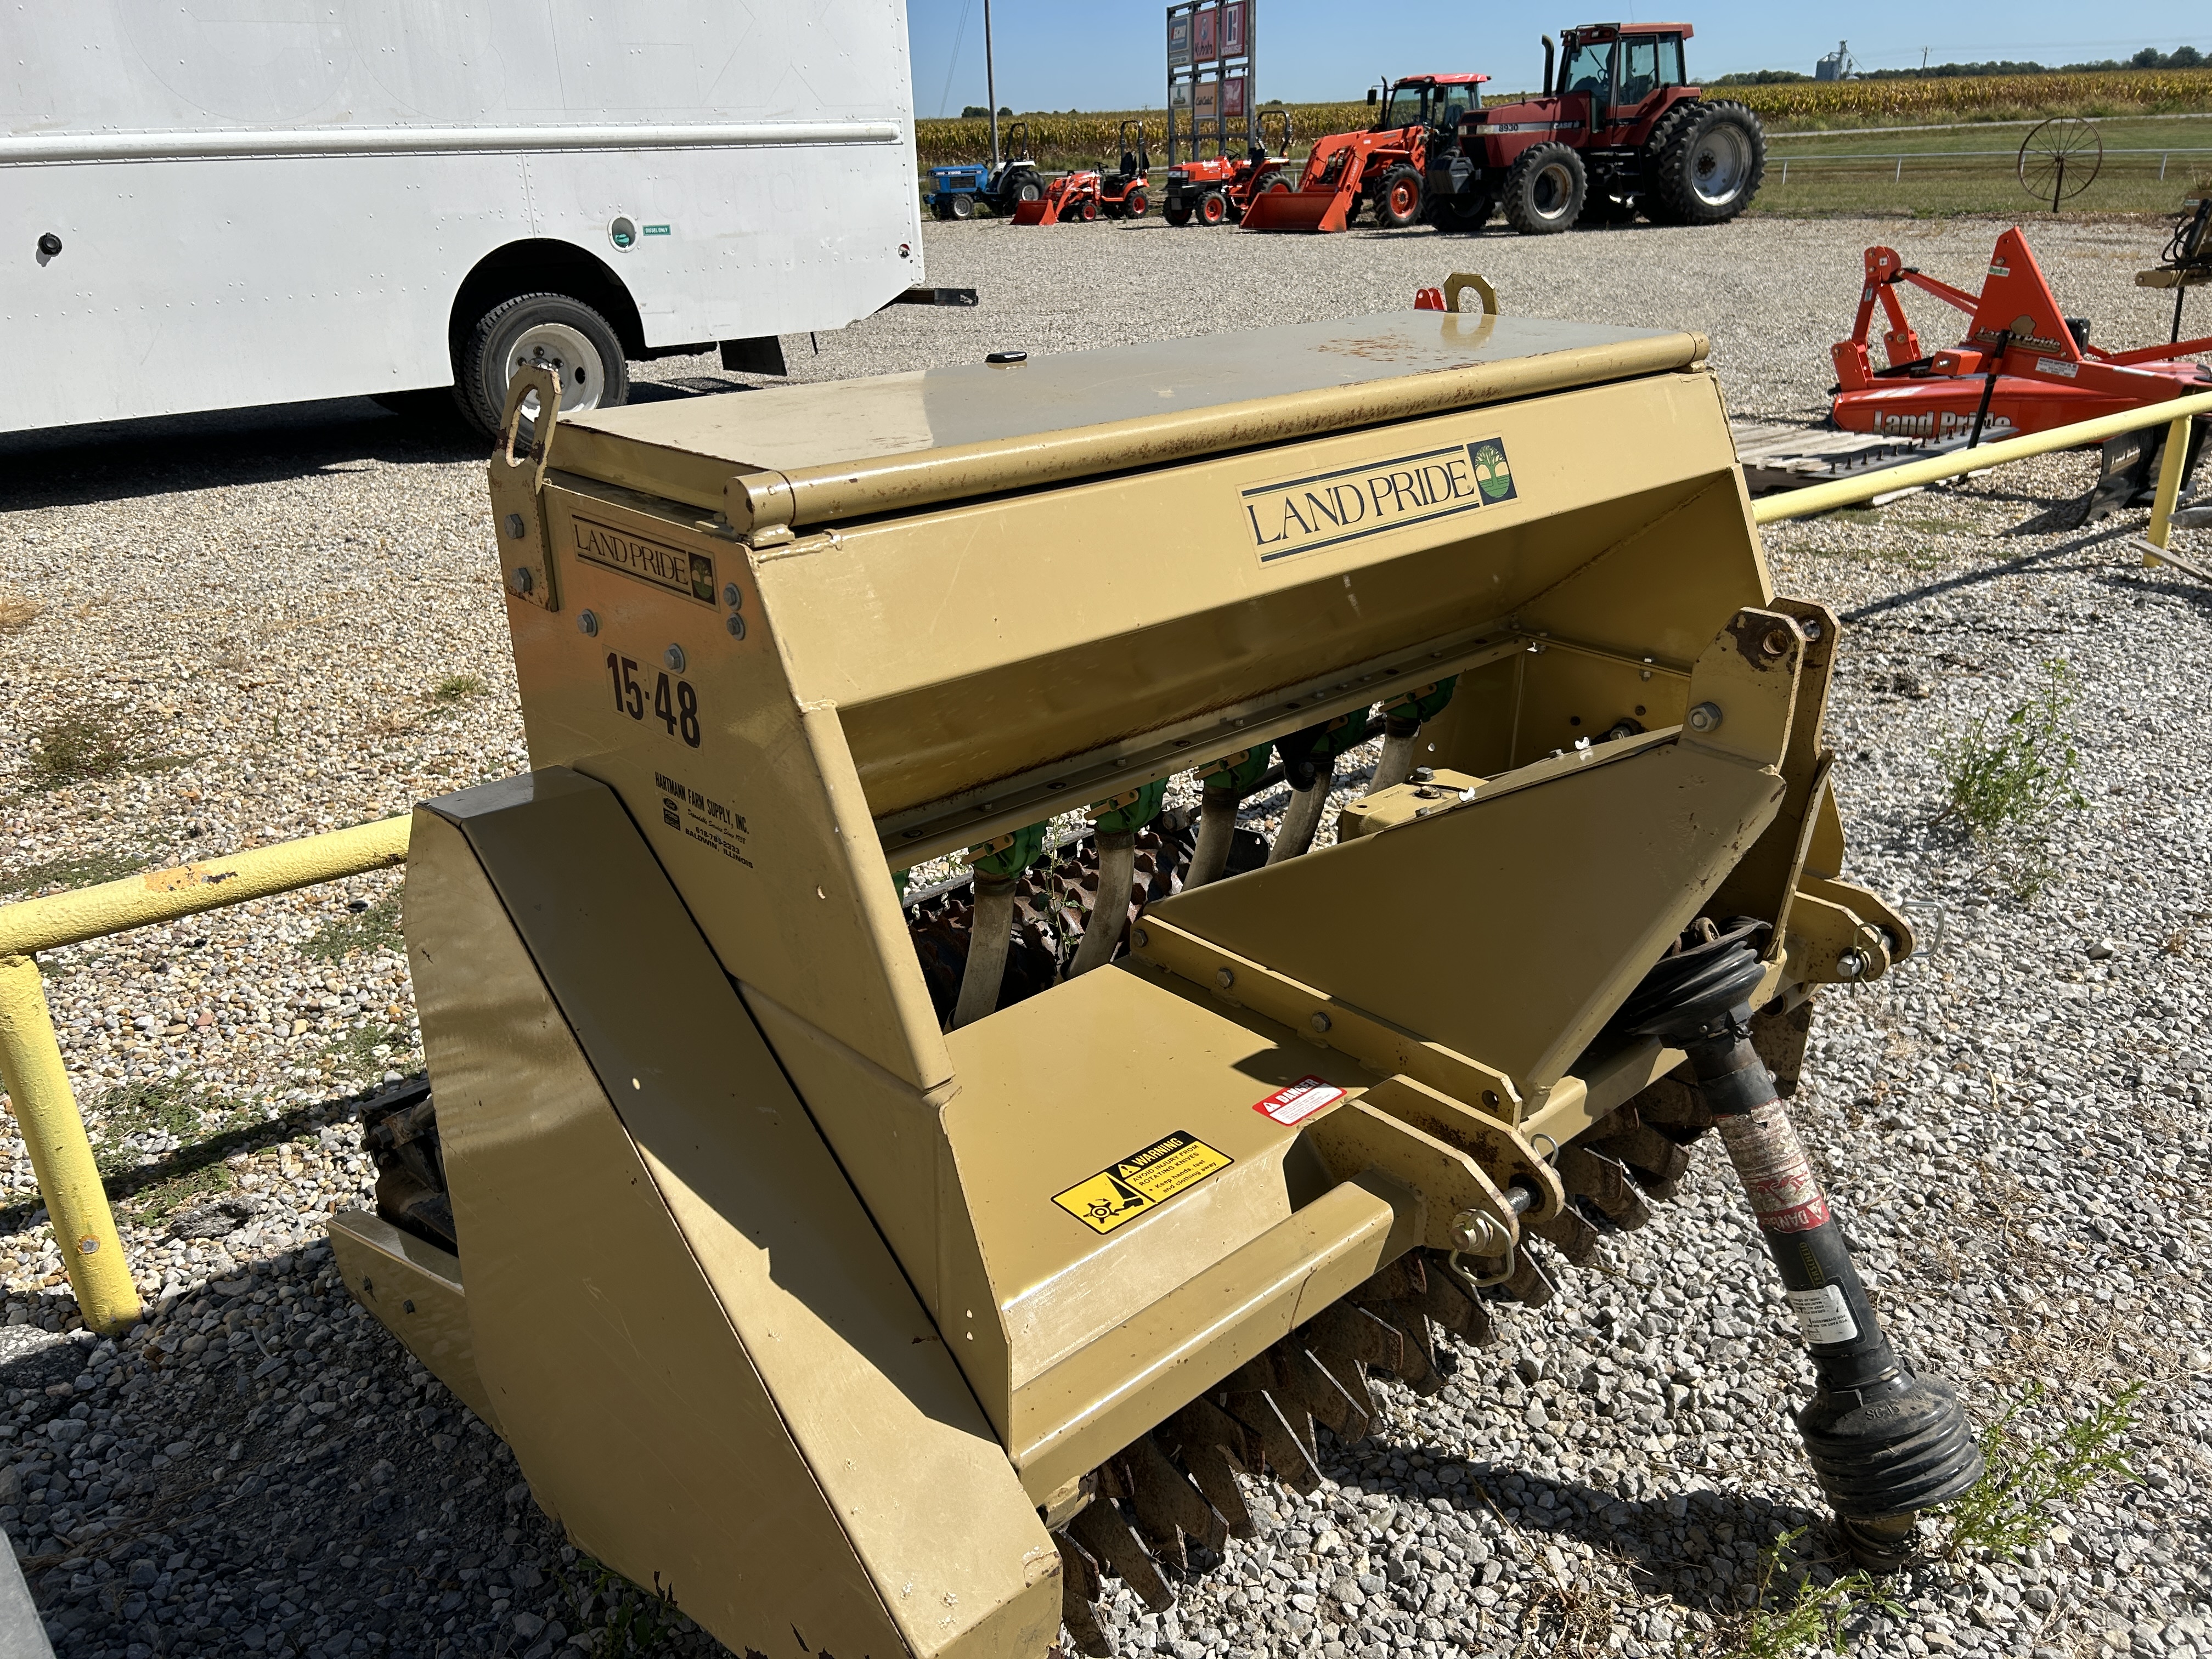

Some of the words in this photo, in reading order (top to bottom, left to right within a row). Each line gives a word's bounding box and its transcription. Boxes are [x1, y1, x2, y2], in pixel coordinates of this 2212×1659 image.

[1221, 44, 1243, 55] KRAUSE
[1499, 123, 1518, 132] 8930
[1873, 410, 1935, 437] Land
[1246, 483, 1365, 546] LAND
[1367, 459, 1475, 518] PRIDE
[574, 523, 627, 563] LAND
[629, 541, 689, 586] PRIDE
[654, 771, 686, 802] HARTMANN
[687, 788, 705, 812] FARM
[707, 799, 734, 830] SUPPLY,
[735, 813, 750, 835] INC.
[723, 848, 754, 869] ILLINOIS
[1274, 1078, 1319, 1104] DANGER
[1131, 1137, 1184, 1166] WARNING
[1132, 1168, 1155, 1182] AVOID
[1154, 1155, 1180, 1170] INJURY
[1179, 1144, 1199, 1156] FROM
[1138, 1165, 1175, 1186] ROTATING
[1175, 1152, 1199, 1167] KNIVES
[1154, 1178, 1172, 1189] Keep
[1171, 1167, 1194, 1180] hands,
[1192, 1159, 1206, 1168] feet
[1163, 1184, 1176, 1193] and
[1175, 1171, 1201, 1186] clothing
[1200, 1161, 1217, 1172] away
[1865, 1408, 1883, 1420] SC
